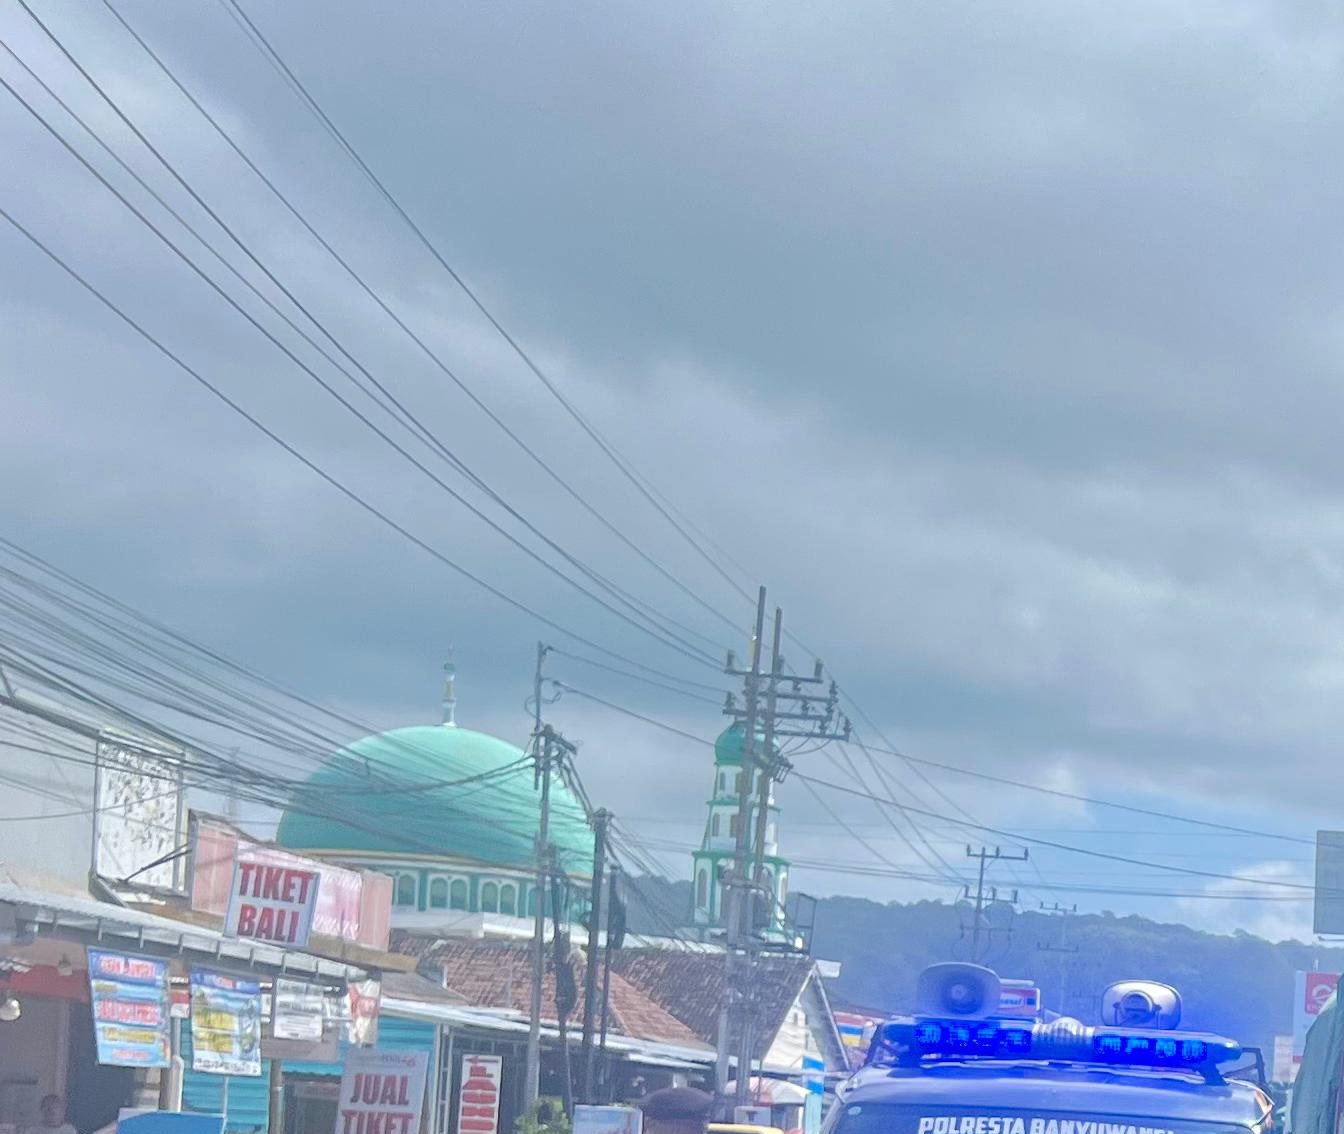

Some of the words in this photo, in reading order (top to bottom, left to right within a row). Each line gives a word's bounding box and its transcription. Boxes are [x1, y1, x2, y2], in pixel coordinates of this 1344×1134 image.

[239, 863, 314, 905] TIKET
[236, 903, 299, 943] BALI
[350, 1072, 410, 1106] JUAL
